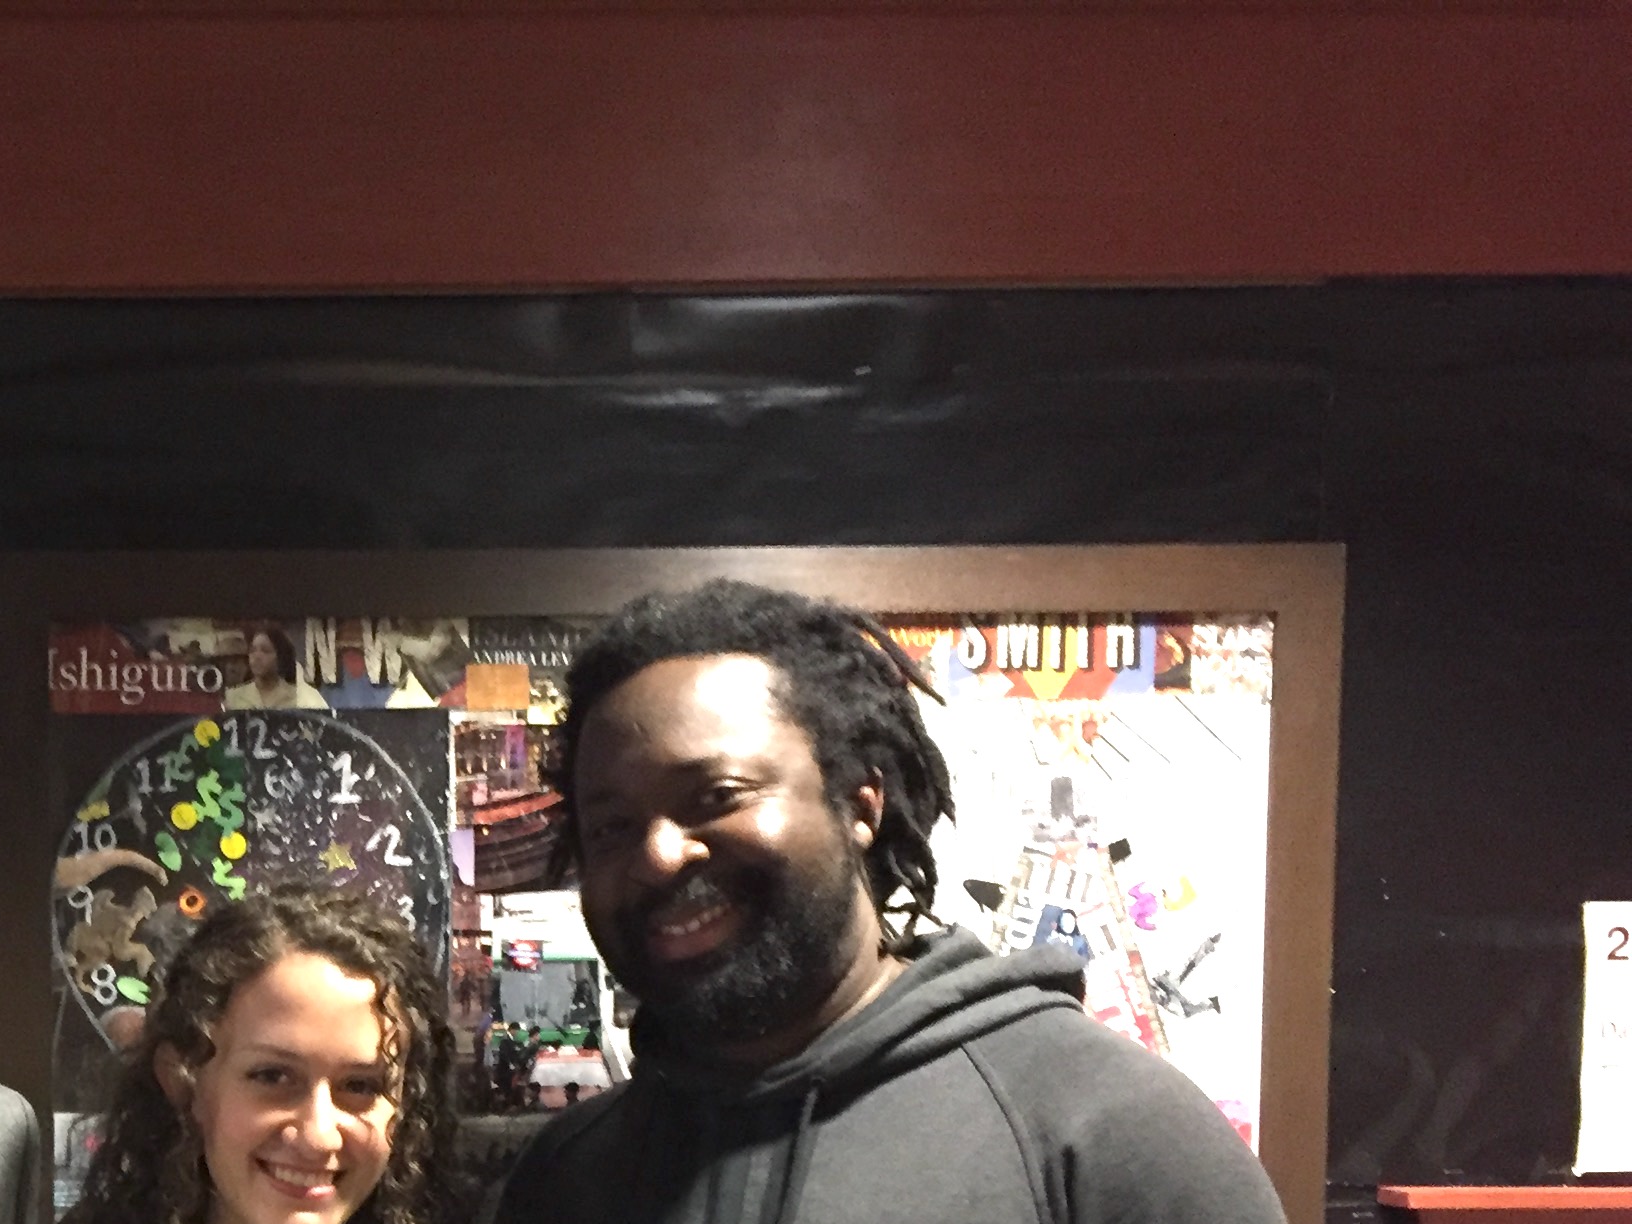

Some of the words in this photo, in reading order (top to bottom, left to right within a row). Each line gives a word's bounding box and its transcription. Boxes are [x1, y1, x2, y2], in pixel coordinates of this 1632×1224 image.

[957, 613, 1135, 671] SMITH
[224, 716, 277, 760] 12
[327, 753, 362, 804] 1
[366, 823, 413, 867] 2
[68, 884, 95, 926] 9
[90, 963, 119, 1006] 8
